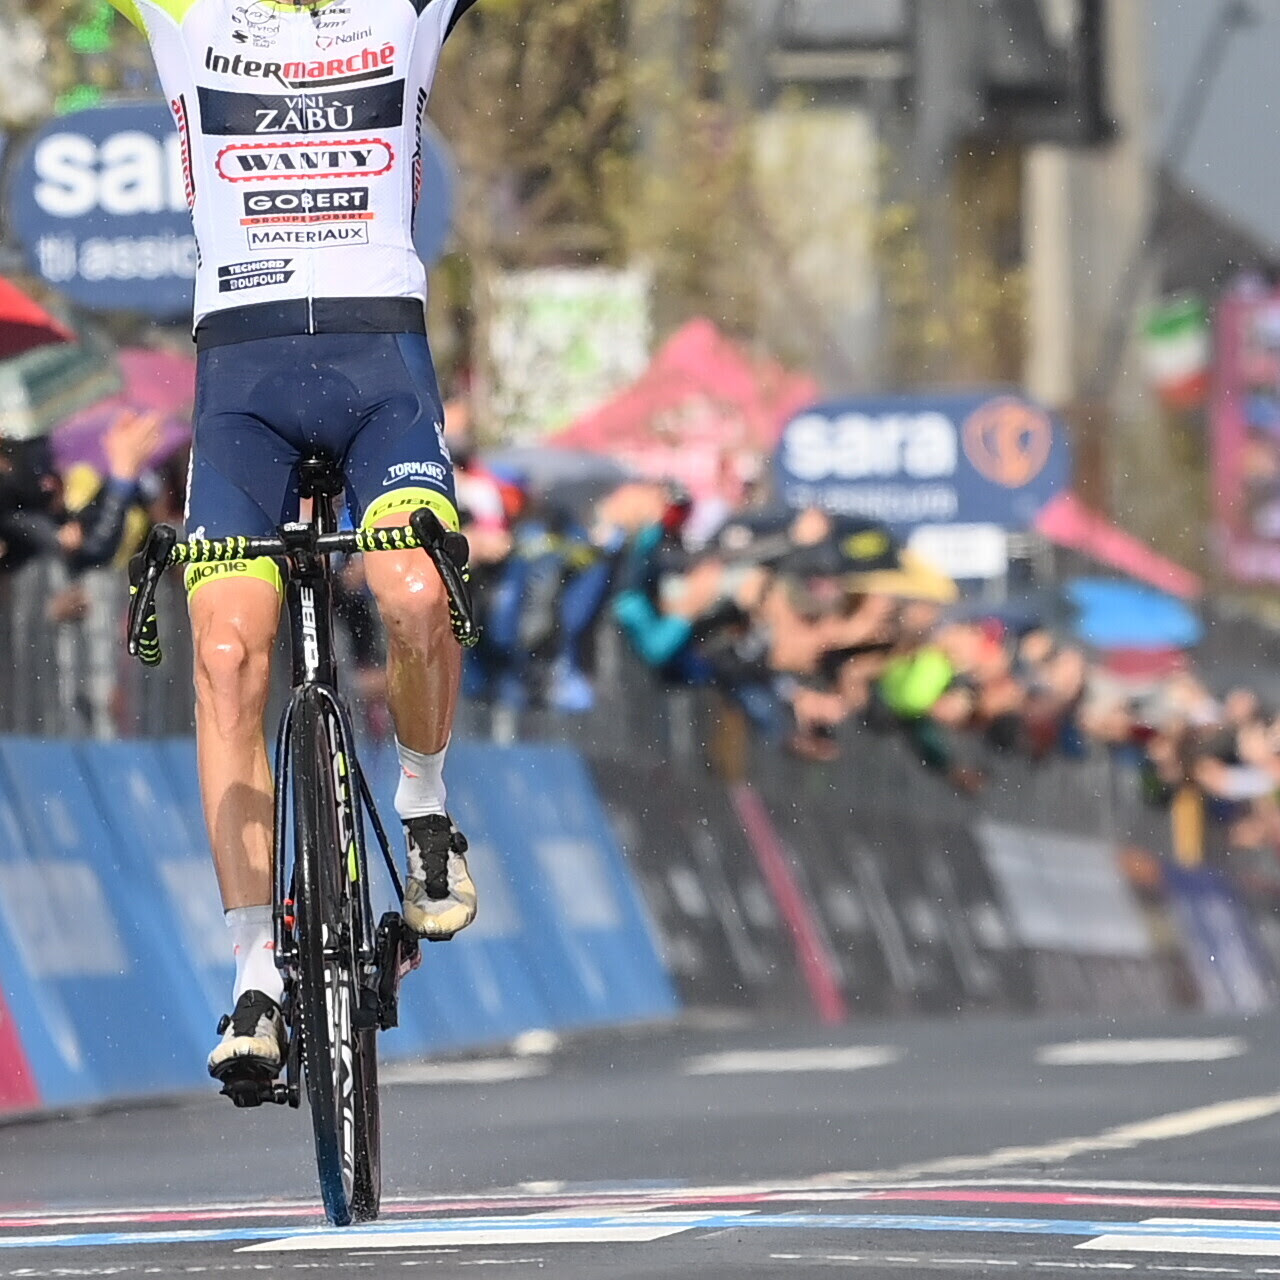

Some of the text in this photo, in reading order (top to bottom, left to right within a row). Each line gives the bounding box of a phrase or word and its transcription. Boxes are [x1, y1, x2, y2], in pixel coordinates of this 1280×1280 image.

[284, 95, 324, 109] VINI
[255, 101, 355, 133] ZABÙ
[236, 149, 373, 172] WANTY
[248, 191, 365, 211] GOBERT
[251, 228, 363, 245] MATERIAUX
[237, 273, 285, 289] DUFOUR
[782, 411, 957, 480] sara
